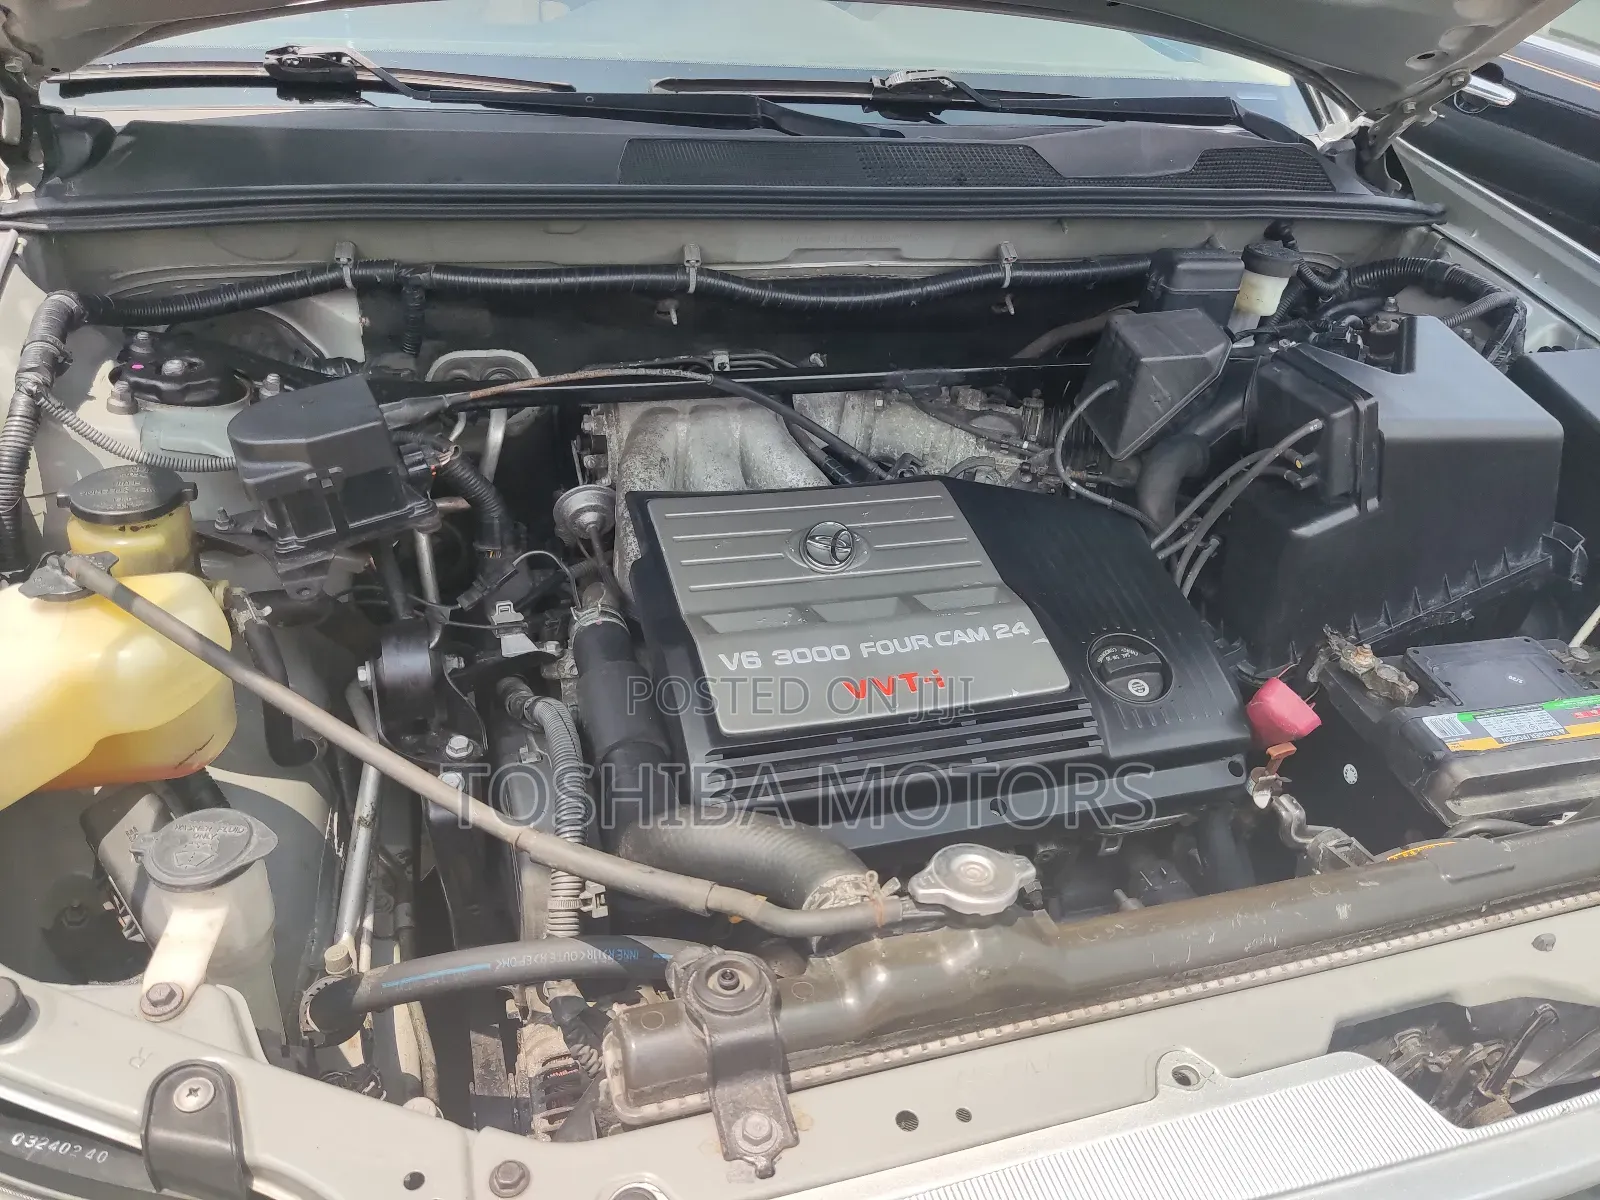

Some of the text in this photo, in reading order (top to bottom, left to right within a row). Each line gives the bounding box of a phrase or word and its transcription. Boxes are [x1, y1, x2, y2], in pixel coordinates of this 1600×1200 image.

[718, 621, 1030, 671] V6 3000 FOUR CAM 24
[193, 832, 218, 841] ONLY
